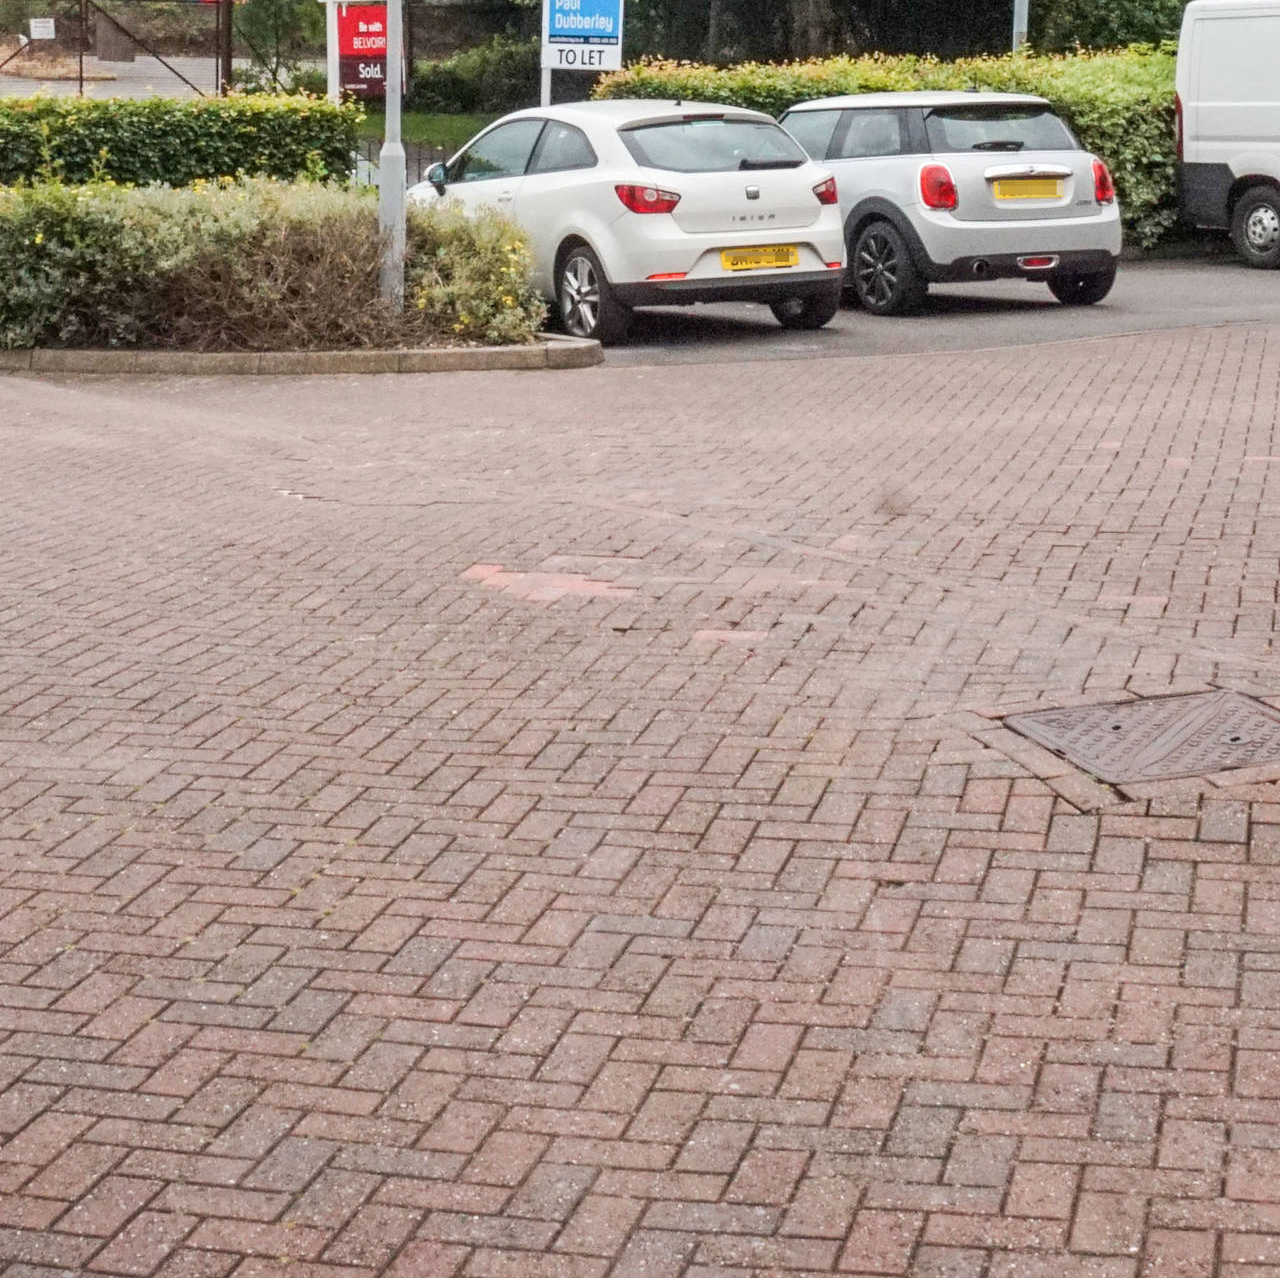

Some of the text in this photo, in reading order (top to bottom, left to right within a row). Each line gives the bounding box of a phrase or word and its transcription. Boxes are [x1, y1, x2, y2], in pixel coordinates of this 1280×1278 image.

[358, 21, 368, 32] Be
[555, 13, 613, 33] Dubberley
[557, 49, 605, 66] TO LET
